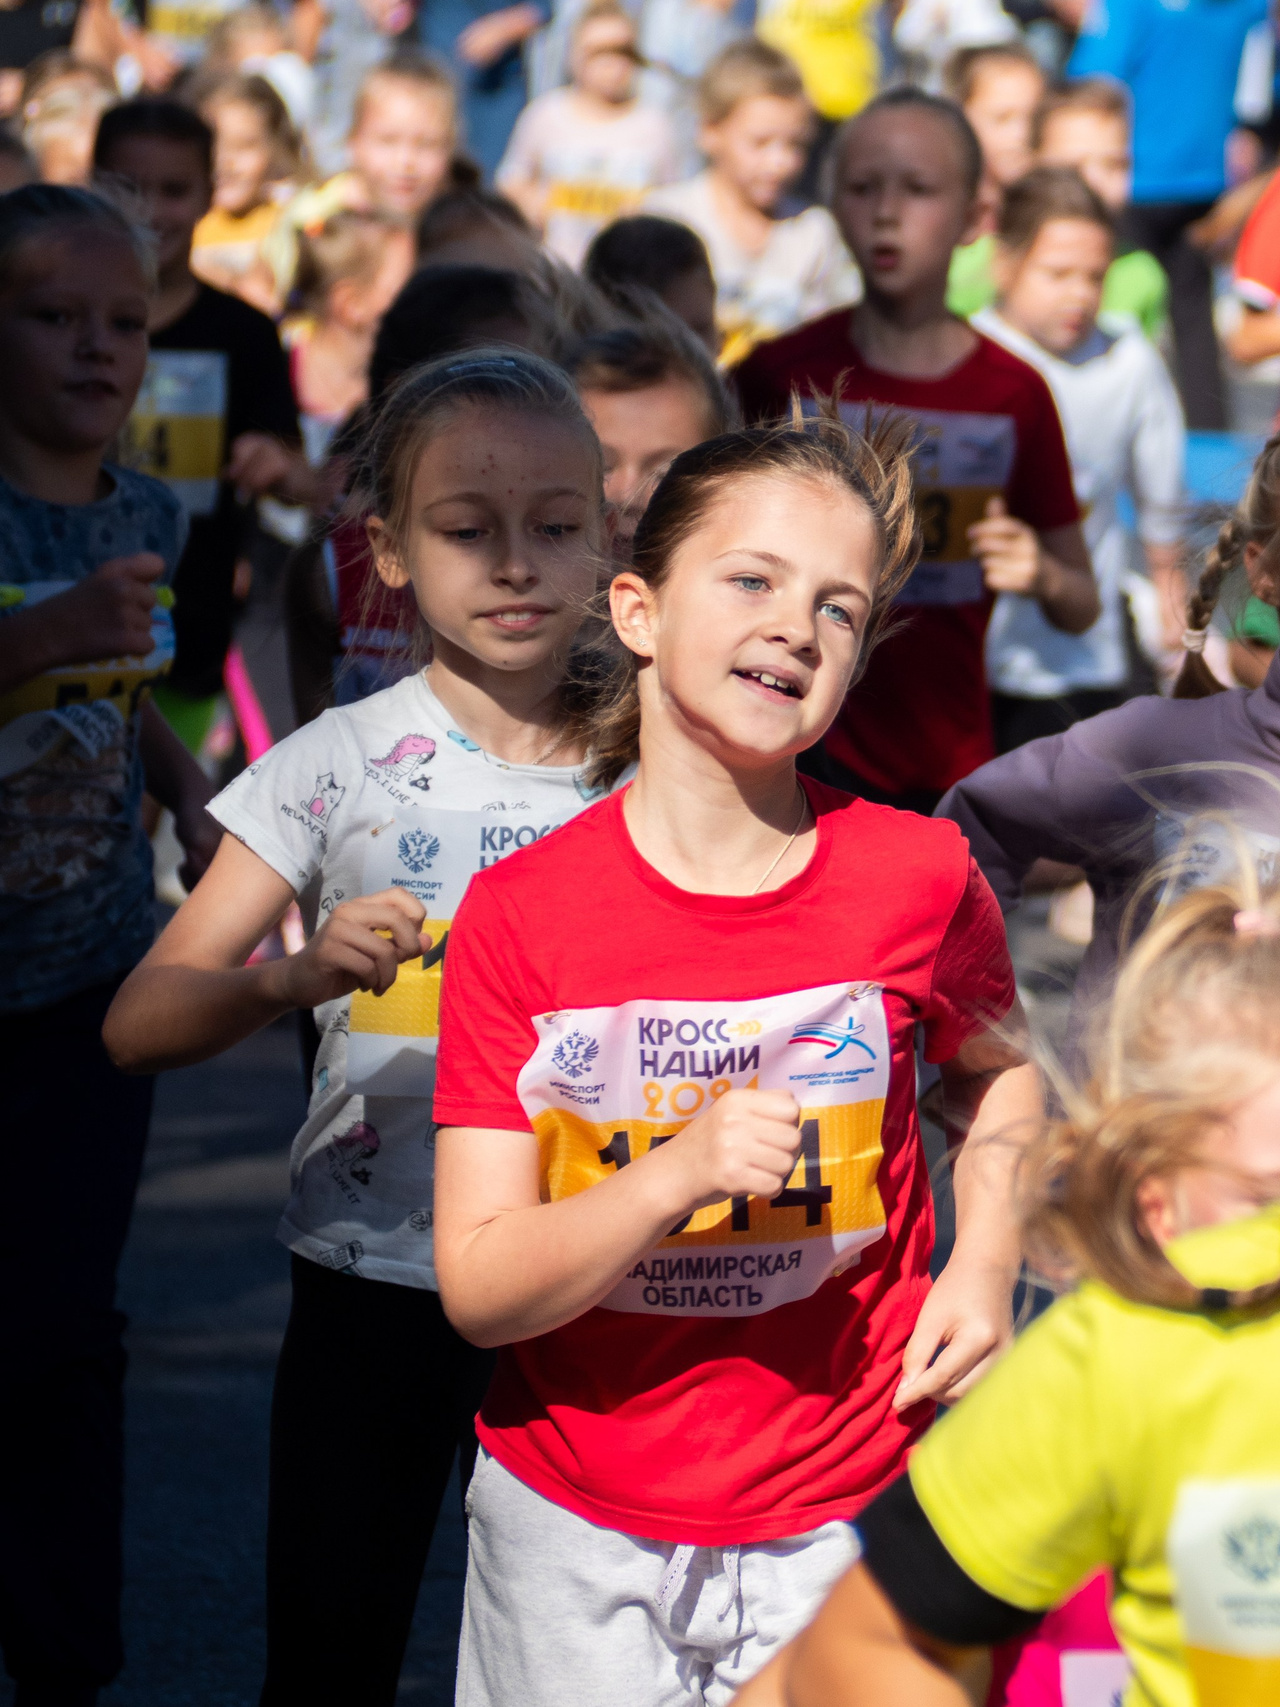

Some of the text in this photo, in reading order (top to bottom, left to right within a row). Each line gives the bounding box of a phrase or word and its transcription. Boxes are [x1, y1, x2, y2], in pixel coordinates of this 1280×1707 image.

[280, 803, 327, 843] RELAXEN
[480, 824, 561, 851] КРОС
[391, 878, 442, 890] МИНСПОРТ
[638, 1017, 731, 1046] КРОСС
[639, 1045, 760, 1080] НАЦИИ
[549, 1081, 606, 1094] МИНСПОРТ
[559, 1090, 600, 1105] РОССИИ
[629, 1250, 803, 1284] АДИМИРСКАЯ
[643, 1285, 763, 1308] ОБЛАСТЬ
